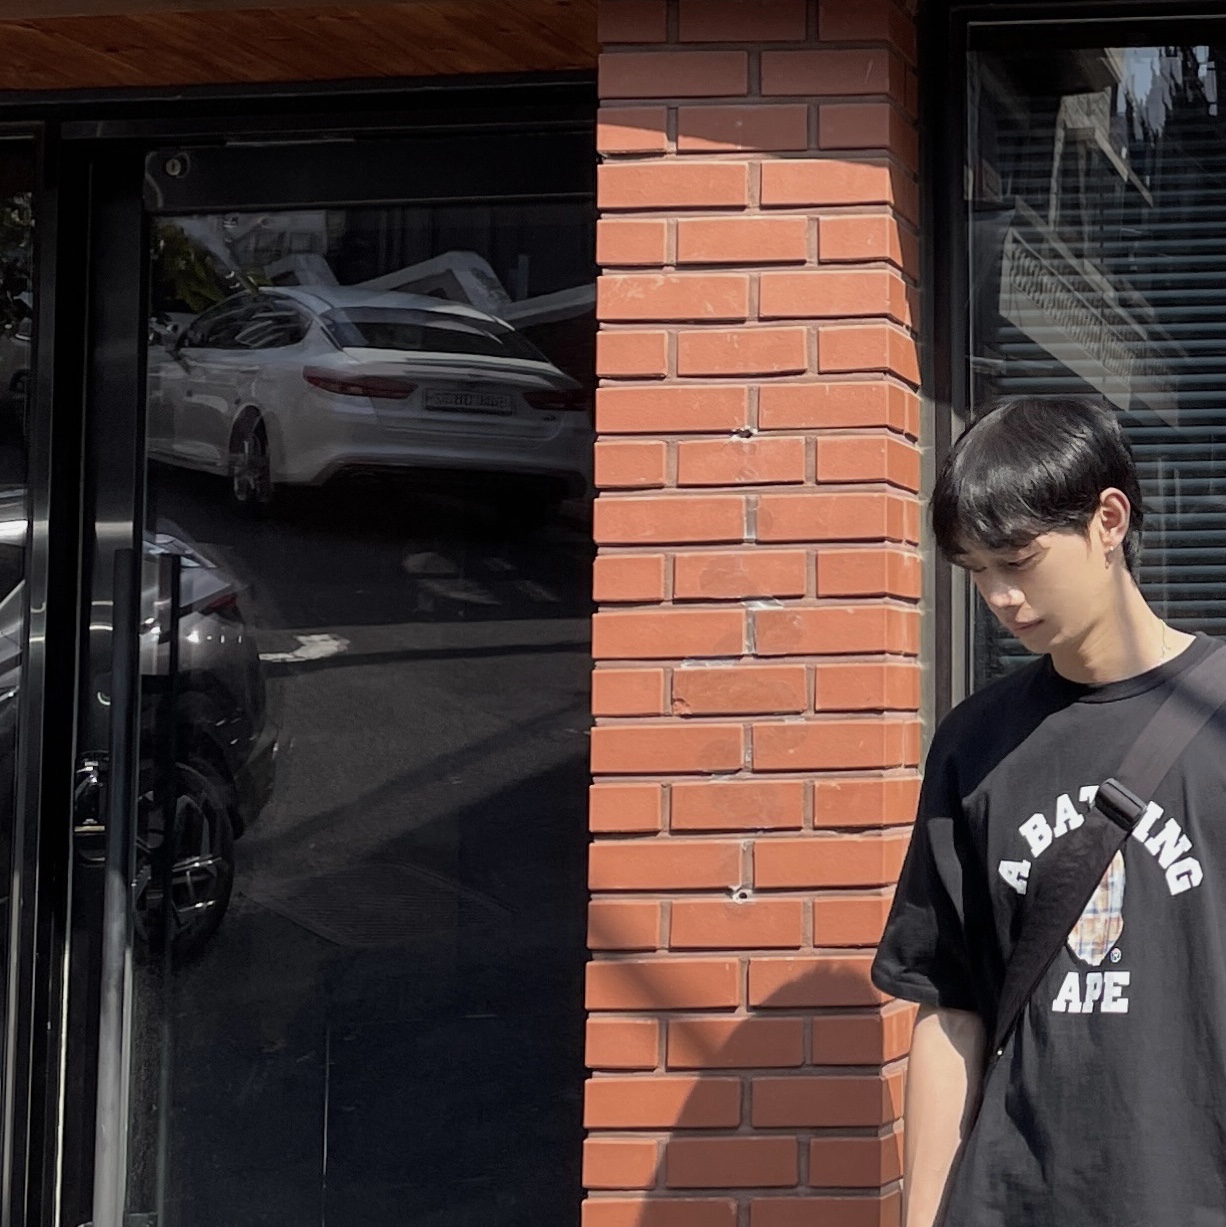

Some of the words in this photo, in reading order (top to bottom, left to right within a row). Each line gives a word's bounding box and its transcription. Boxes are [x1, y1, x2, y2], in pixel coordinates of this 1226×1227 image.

[998, 859, 1031, 896] A
[1018, 785, 1203, 896] BAING
[1052, 971, 1130, 1013] APE
